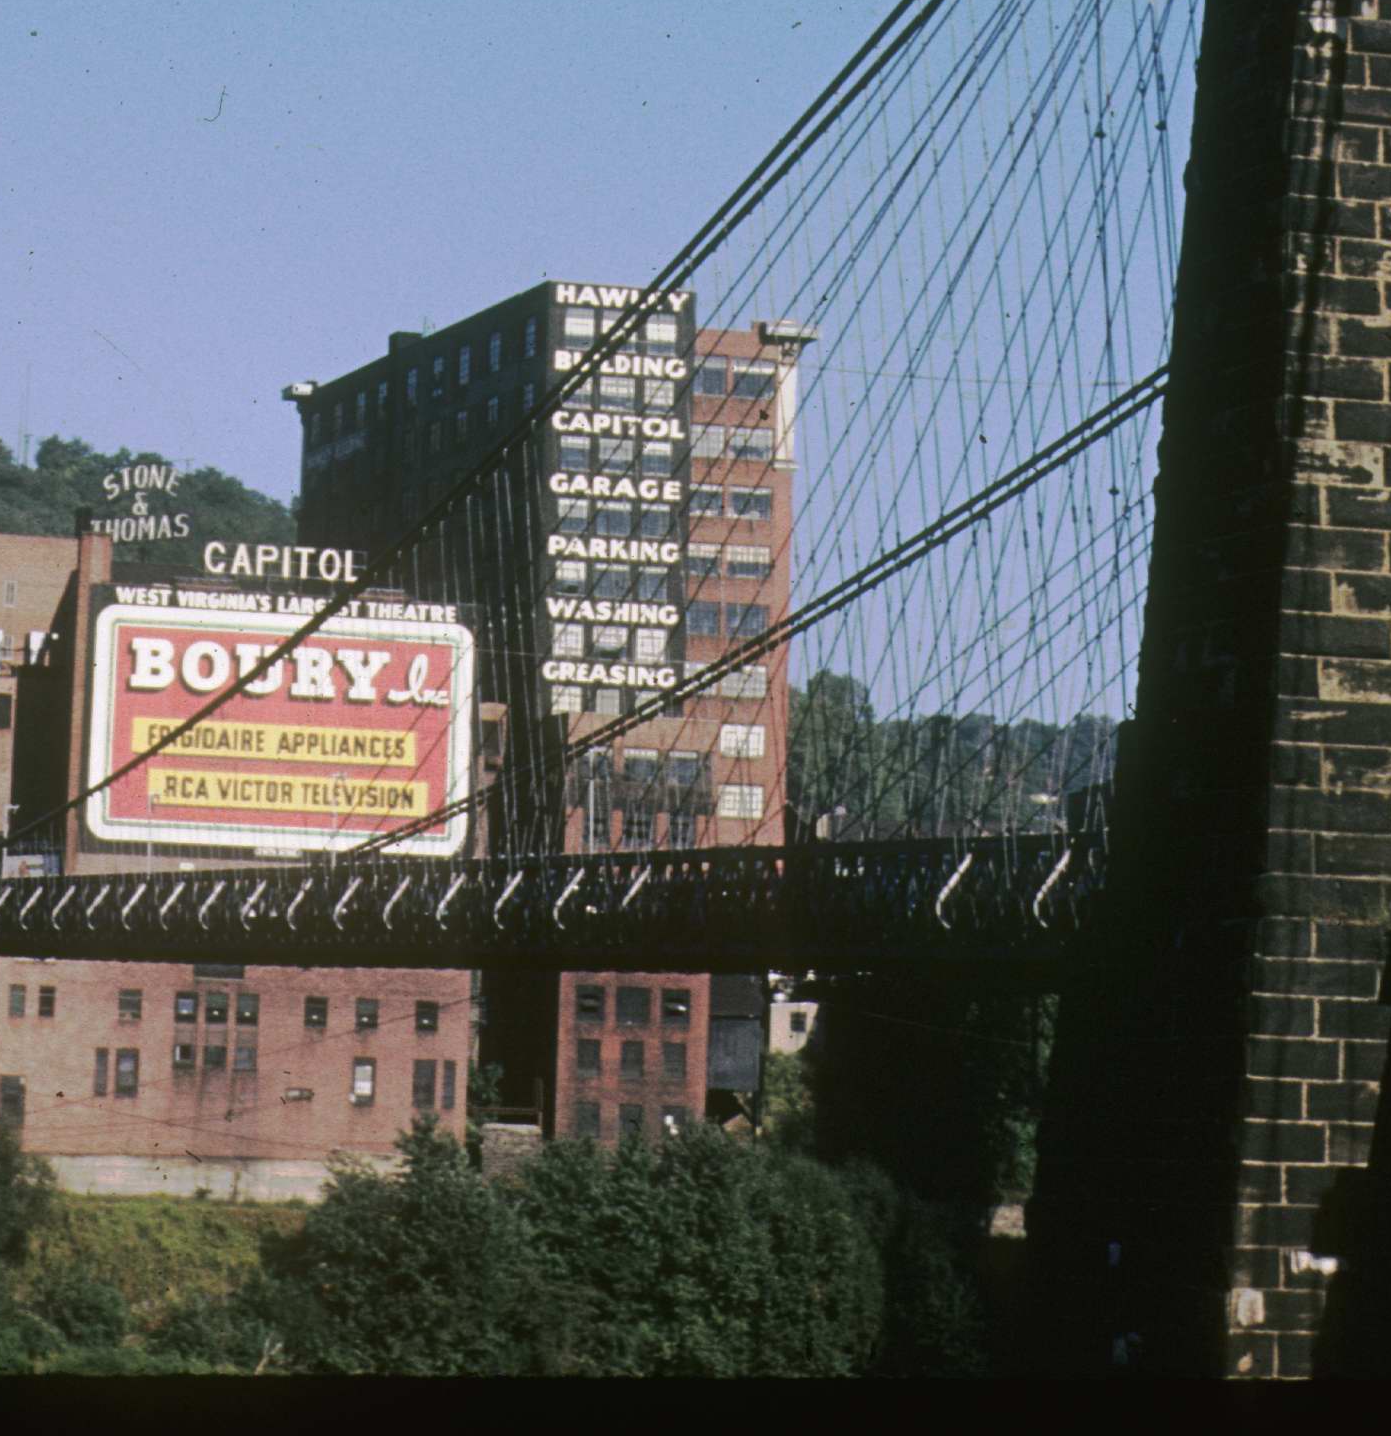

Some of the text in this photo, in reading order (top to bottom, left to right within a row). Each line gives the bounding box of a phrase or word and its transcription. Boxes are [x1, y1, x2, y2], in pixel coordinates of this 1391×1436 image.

[552, 411, 685, 439] CAPITOL
[103, 464, 181, 500] STONE
[549, 472, 682, 501] GARAGE
[132, 492, 149, 516] &
[90, 514, 190, 543] THOMAS
[204, 540, 358, 583] CAPITOL
[547, 534, 680, 564] PARKING
[115, 586, 457, 623] WEST VIRGINIA'S LARGST THEATRE
[546, 596, 679, 626] WASHING
[129, 636, 450, 706] BOURY Inc
[542, 660, 677, 688] GREASING
[277, 730, 406, 759] APPLIANCES
[165, 775, 414, 809] RCA VICTOR TELEVISION
